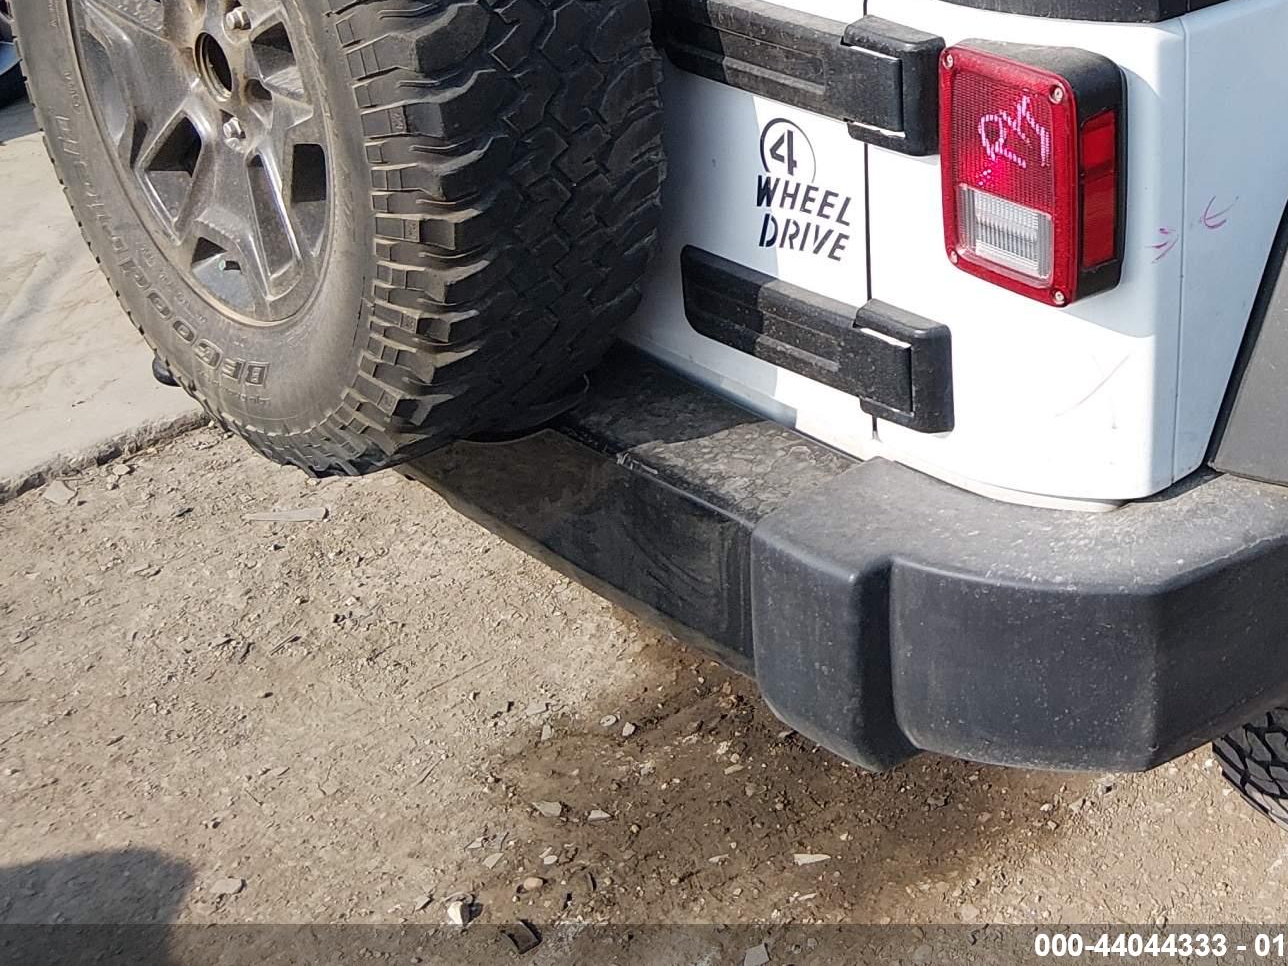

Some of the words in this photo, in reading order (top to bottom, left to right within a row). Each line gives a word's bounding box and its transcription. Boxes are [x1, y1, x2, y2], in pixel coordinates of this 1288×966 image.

[769, 129, 798, 176] 4
[756, 175, 852, 226] WHEEL
[758, 213, 851, 262] DRIVE
